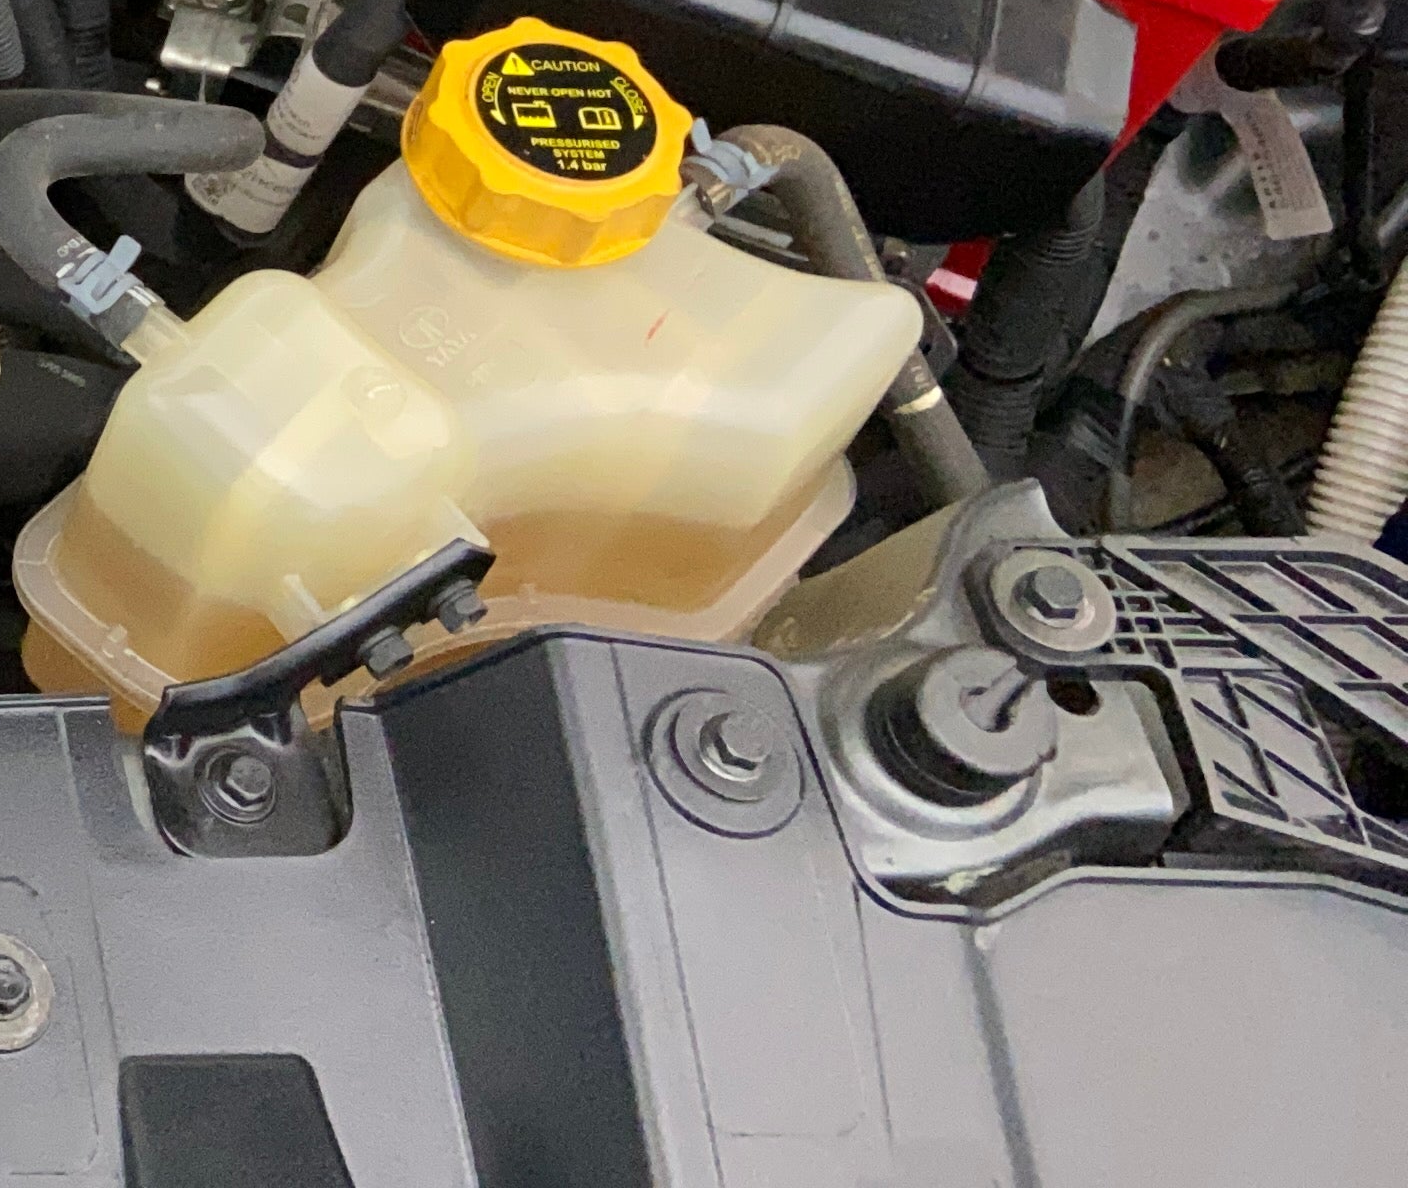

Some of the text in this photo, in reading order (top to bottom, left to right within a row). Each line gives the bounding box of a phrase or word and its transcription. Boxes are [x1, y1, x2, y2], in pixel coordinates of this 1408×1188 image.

[530, 58, 602, 73] CAUTION
[480, 71, 501, 104] OPEN
[506, 85, 614, 100] NEVER OPEN HOT
[613, 75, 648, 115] CLOSE
[530, 136, 621, 151] PRESSURISED
[553, 148, 606, 160] SYSTEM
[556, 159, 608, 172] 1.4 bar
